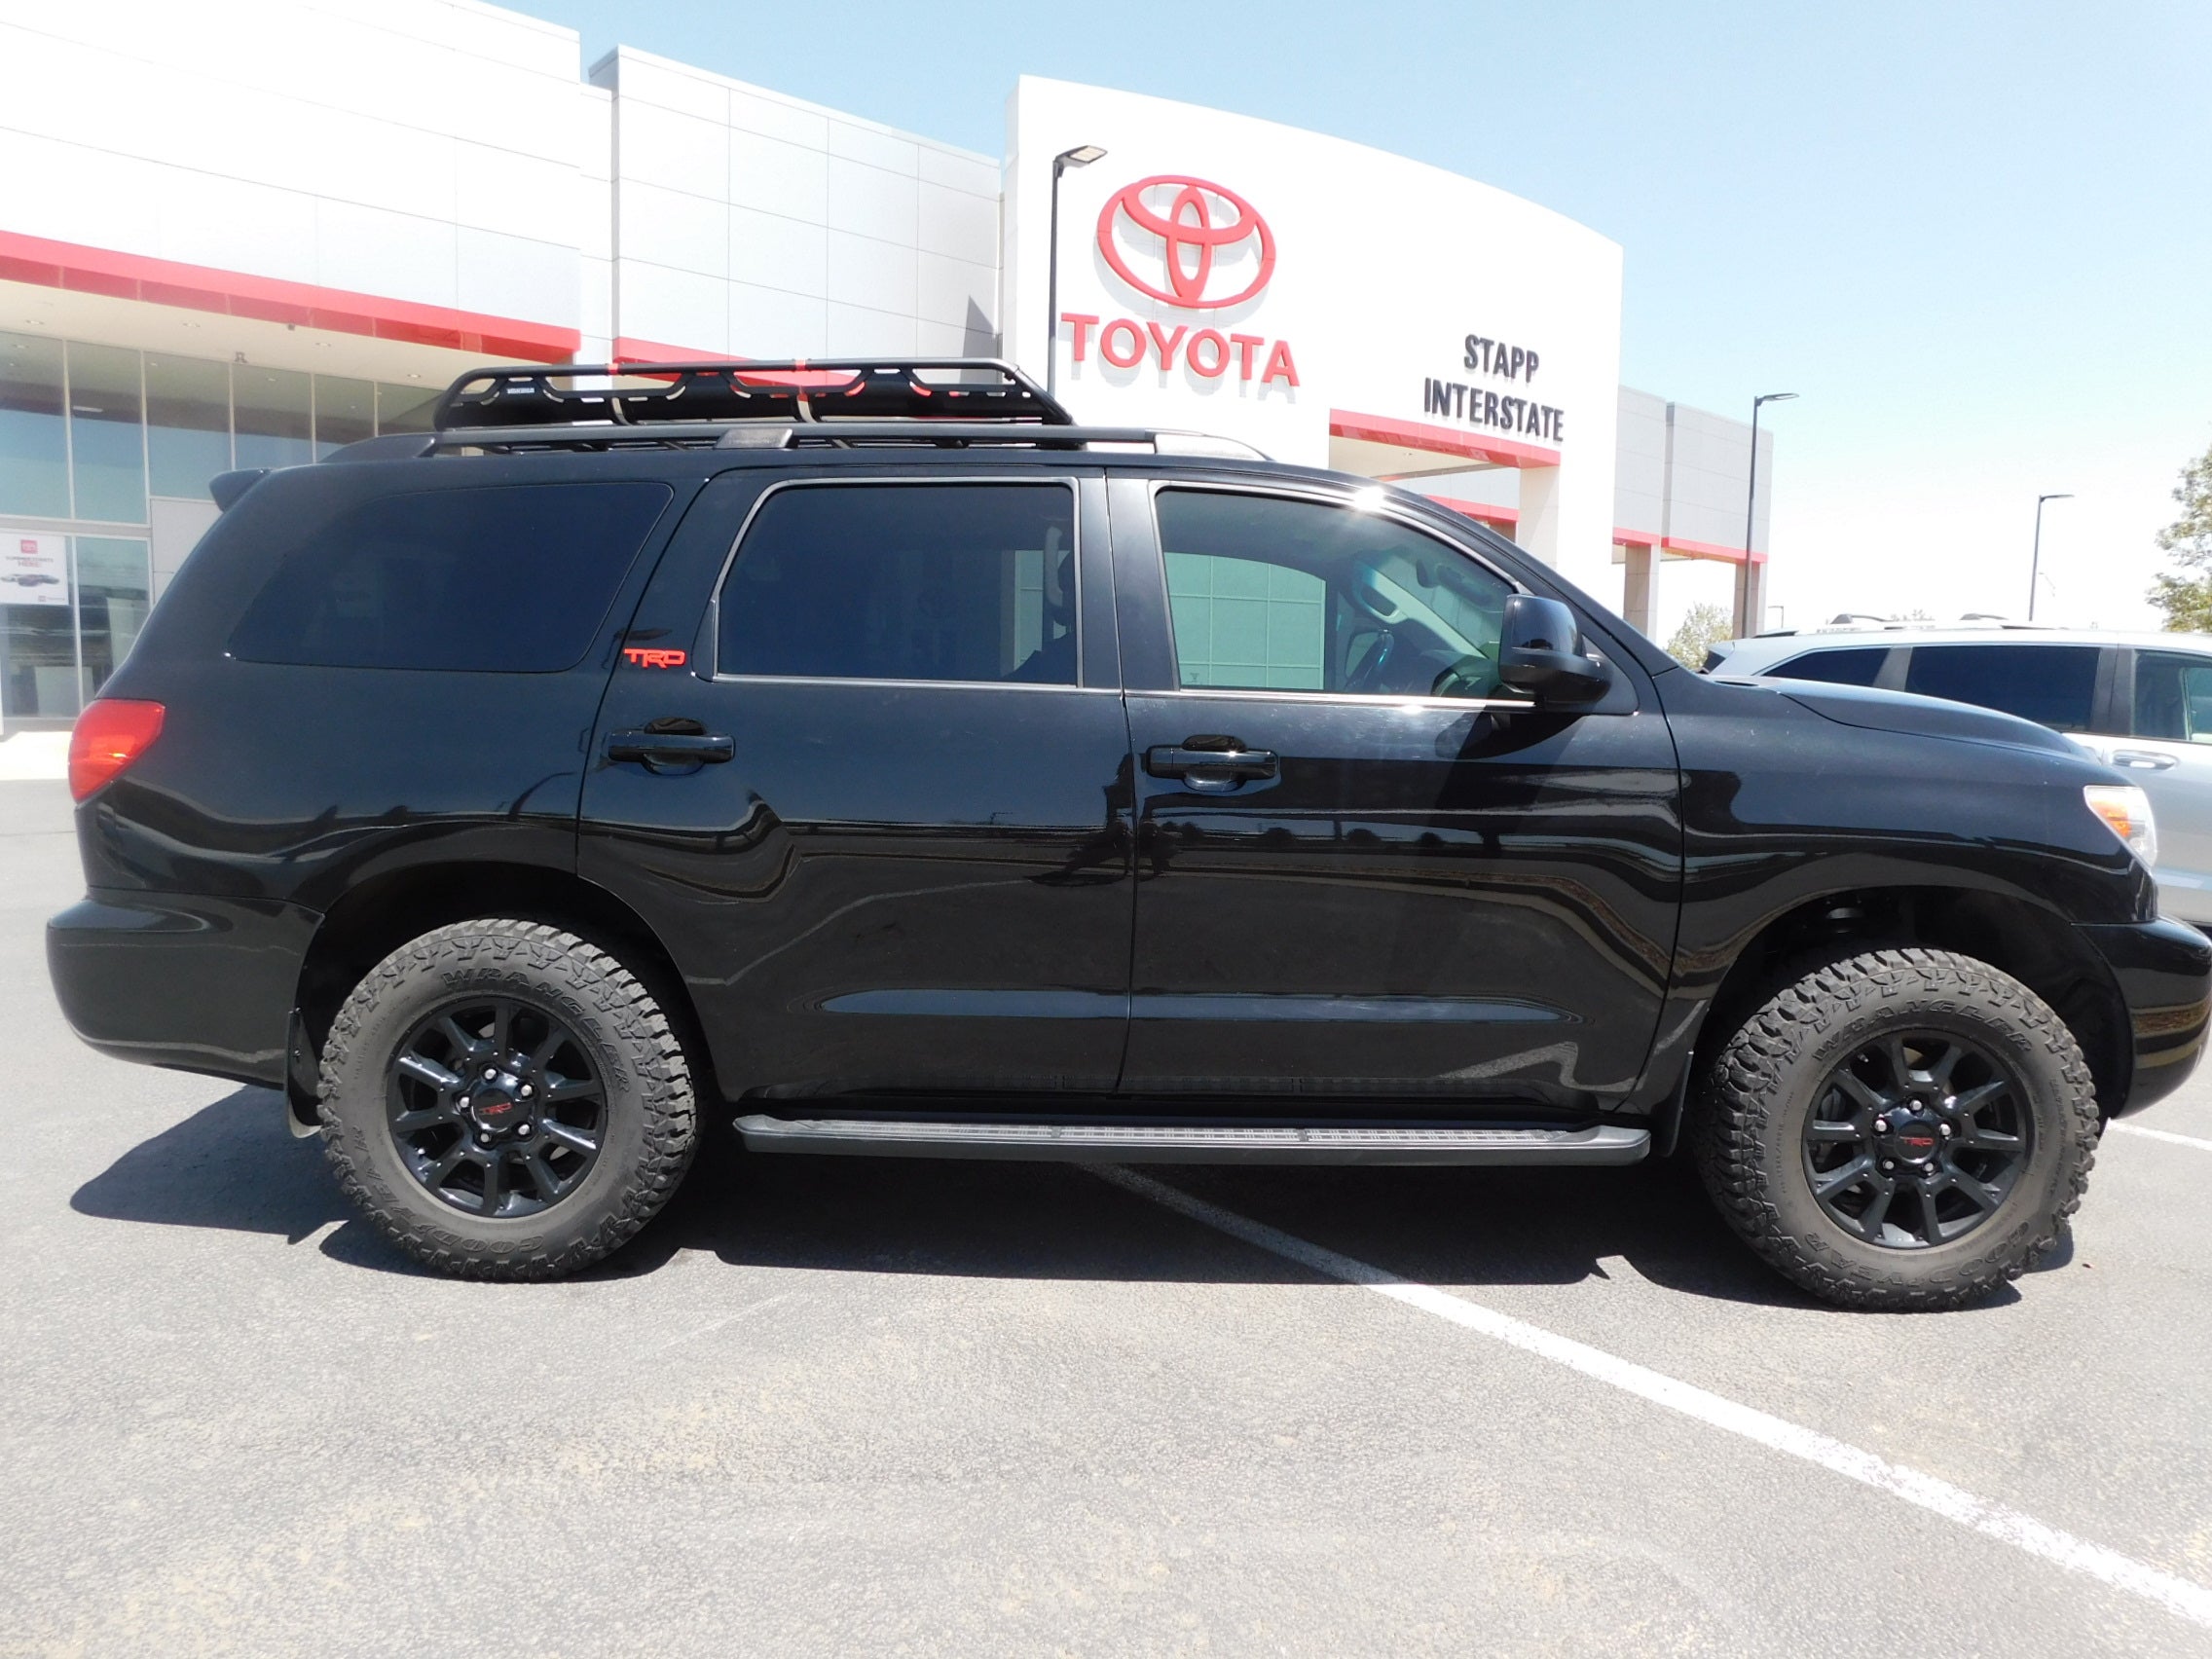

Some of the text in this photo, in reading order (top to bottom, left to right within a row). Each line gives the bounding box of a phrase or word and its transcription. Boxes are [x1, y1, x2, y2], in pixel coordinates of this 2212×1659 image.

[1061, 313, 1300, 387] TOYOTA
[1463, 334, 1539, 383] STAPP
[1424, 377, 1565, 442] INTERSTATE
[624, 647, 685, 669] TRD
[441, 968, 630, 1092] WRANGLER
[1813, 999, 2033, 1060] WRANGLER
[351, 1124, 545, 1254] GOODYEAR
[1804, 1221, 2029, 1287] GOODYEAR
